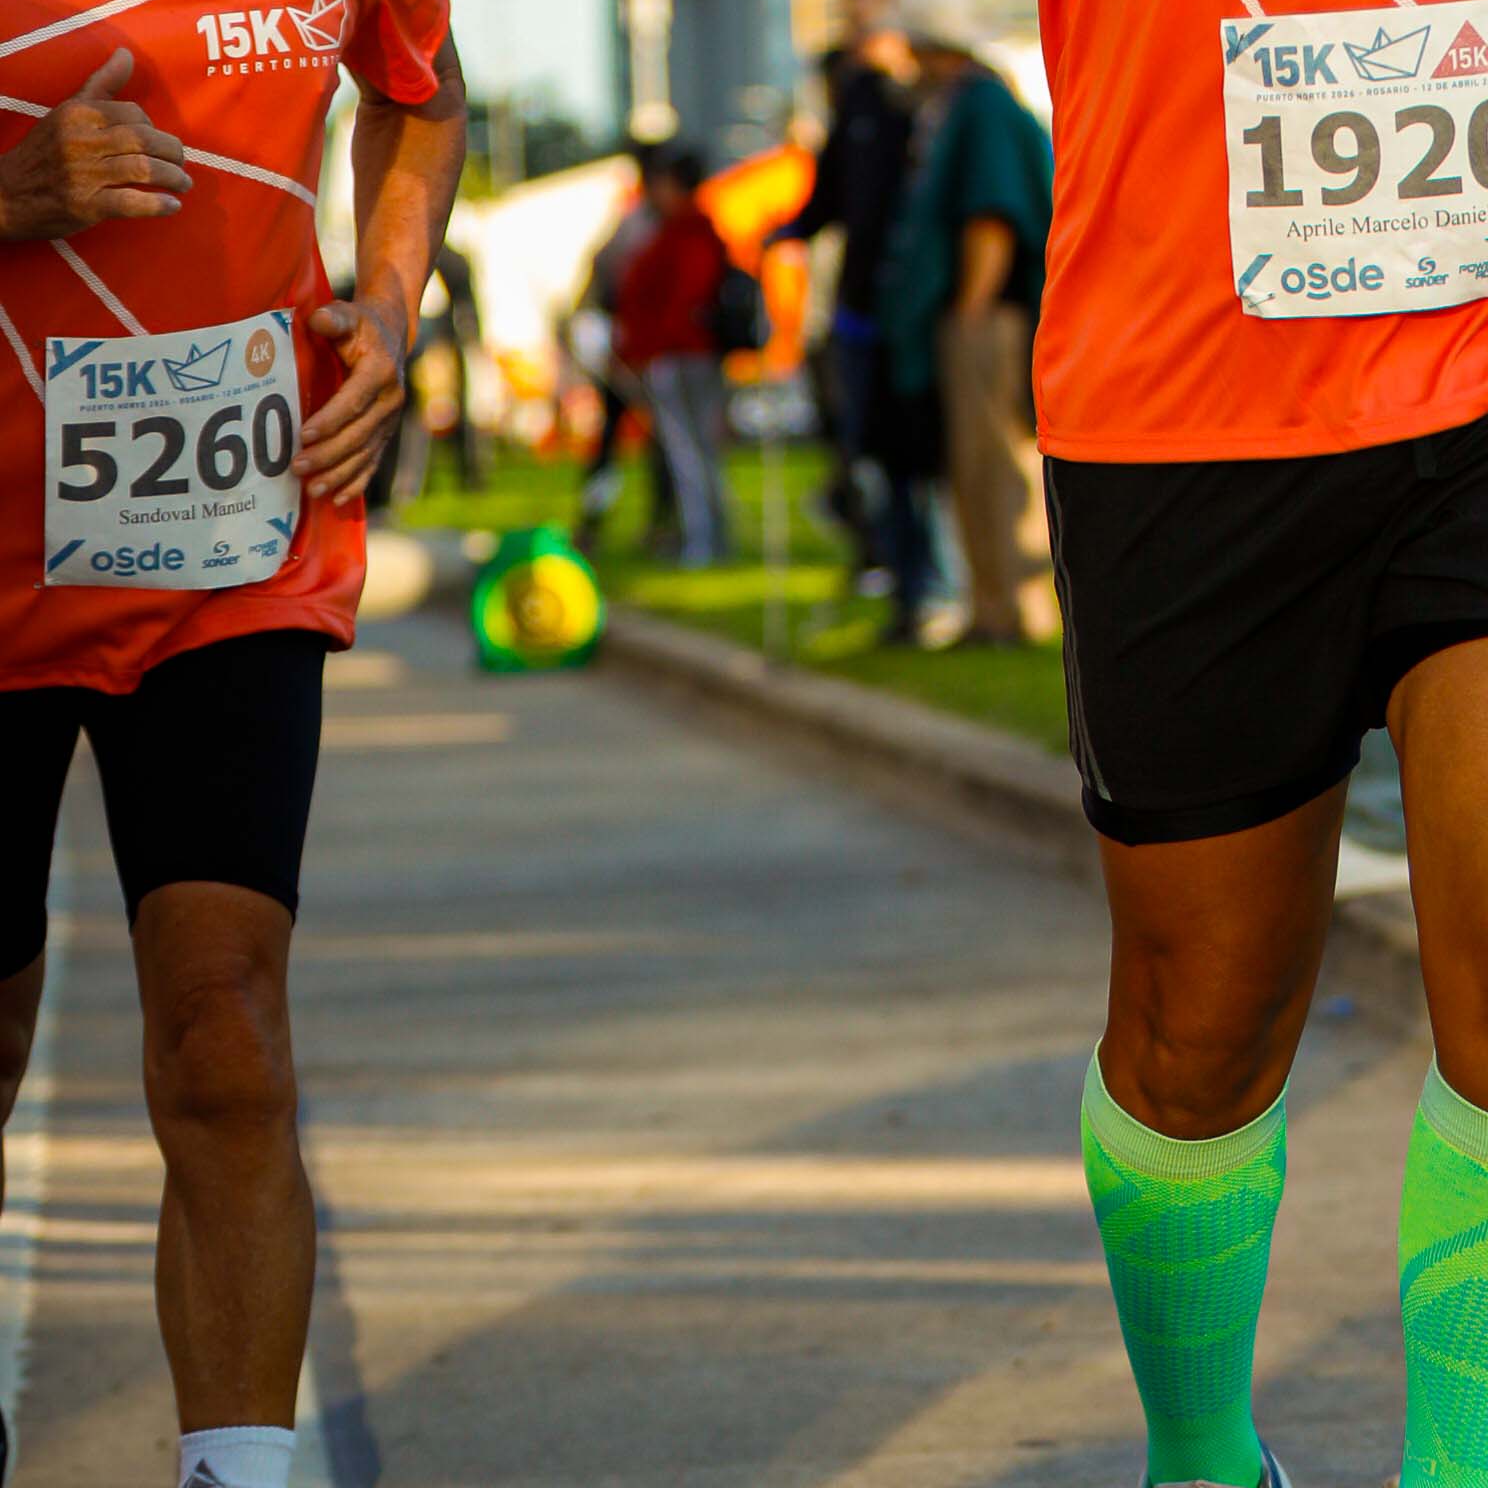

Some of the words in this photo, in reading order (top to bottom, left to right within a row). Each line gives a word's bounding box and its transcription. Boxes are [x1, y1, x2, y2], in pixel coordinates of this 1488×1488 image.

[196, 8, 291, 60] 15K
[207, 58, 292, 76] PUERTO
[1254, 43, 1339, 87] 15K
[1256, 93, 1293, 102] PUERTO
[1296, 91, 1327, 101] NORTE
[1366, 86, 1410, 96] ROSARIO
[1436, 81, 1448, 90] DE
[1452, 78, 1480, 89] ABRIL
[1287, 218, 1345, 241] Aprile
[1352, 213, 1429, 234] Marcelo
[1281, 257, 1385, 300] osde
[250, 343, 271, 363] 4K
[80, 360, 157, 399] 15K
[57, 393, 293, 502] 5260
[119, 504, 195, 525] Sandoval
[202, 495, 256, 519] Manuel
[91, 542, 185, 576] osde
